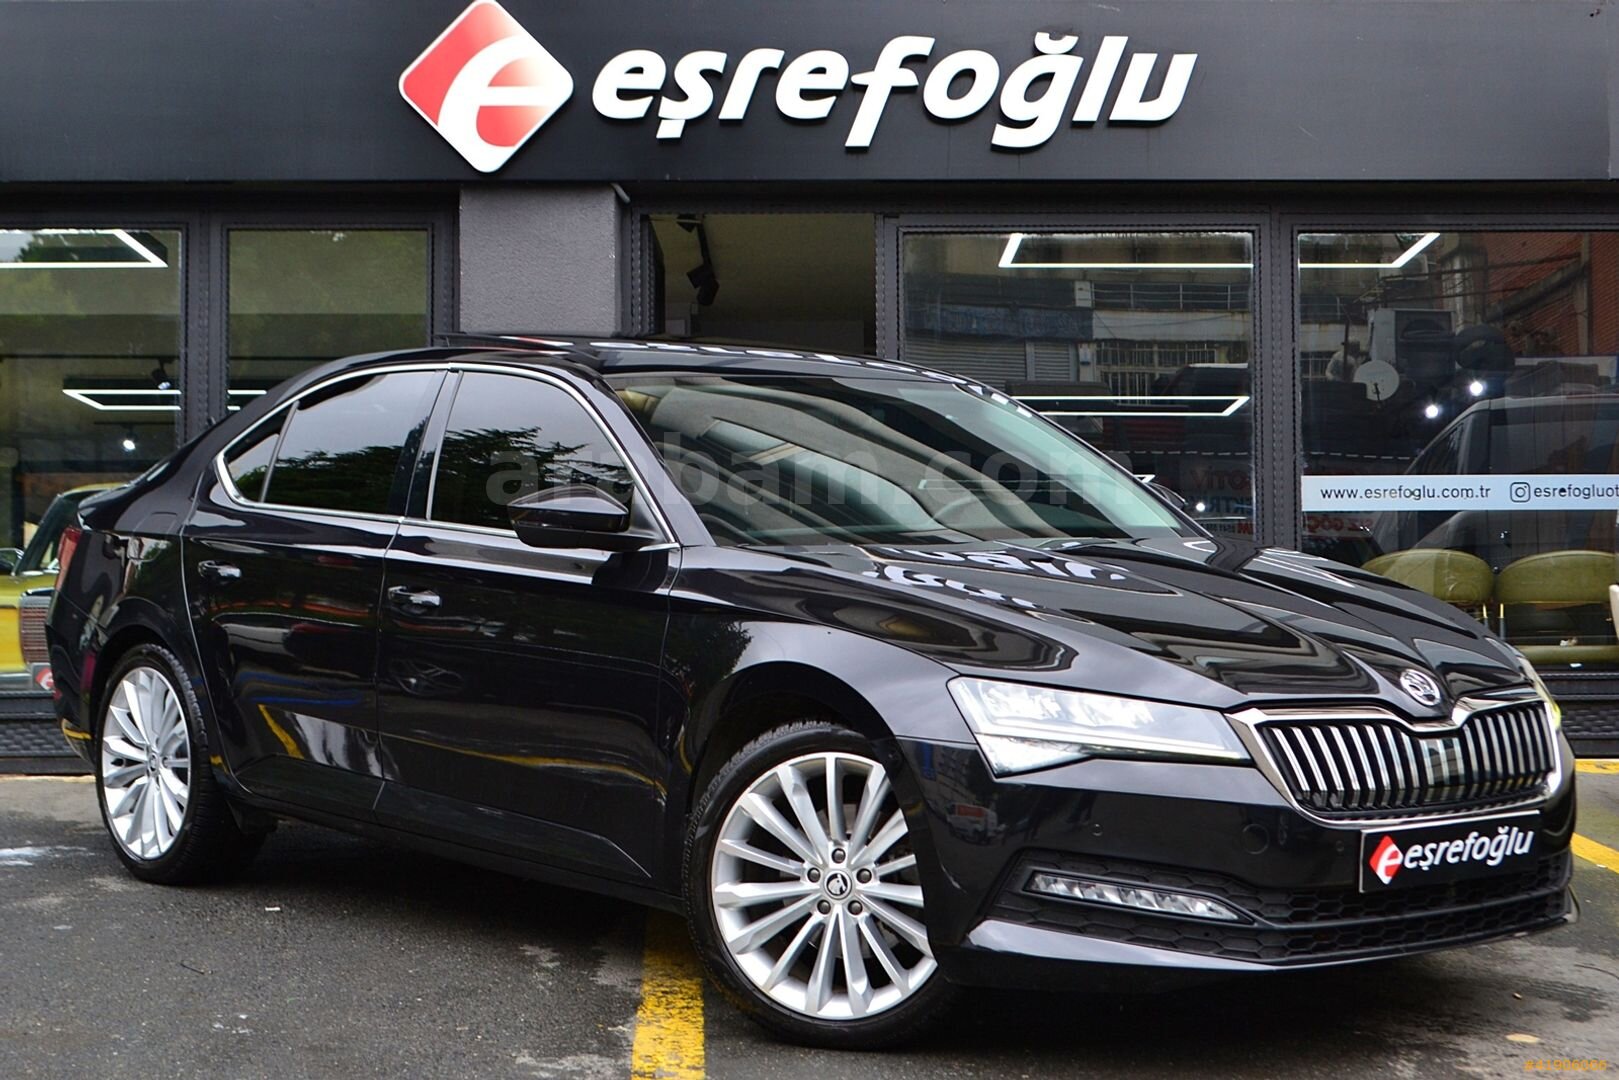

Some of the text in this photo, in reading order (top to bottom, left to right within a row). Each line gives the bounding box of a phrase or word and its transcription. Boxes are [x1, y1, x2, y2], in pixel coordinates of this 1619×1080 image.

[593, 32, 1198, 148] eşrefoğlu
[1320, 485, 1491, 500] www.esrefoglu.com.tr
[1403, 826, 1534, 871] eşrefoğlu
